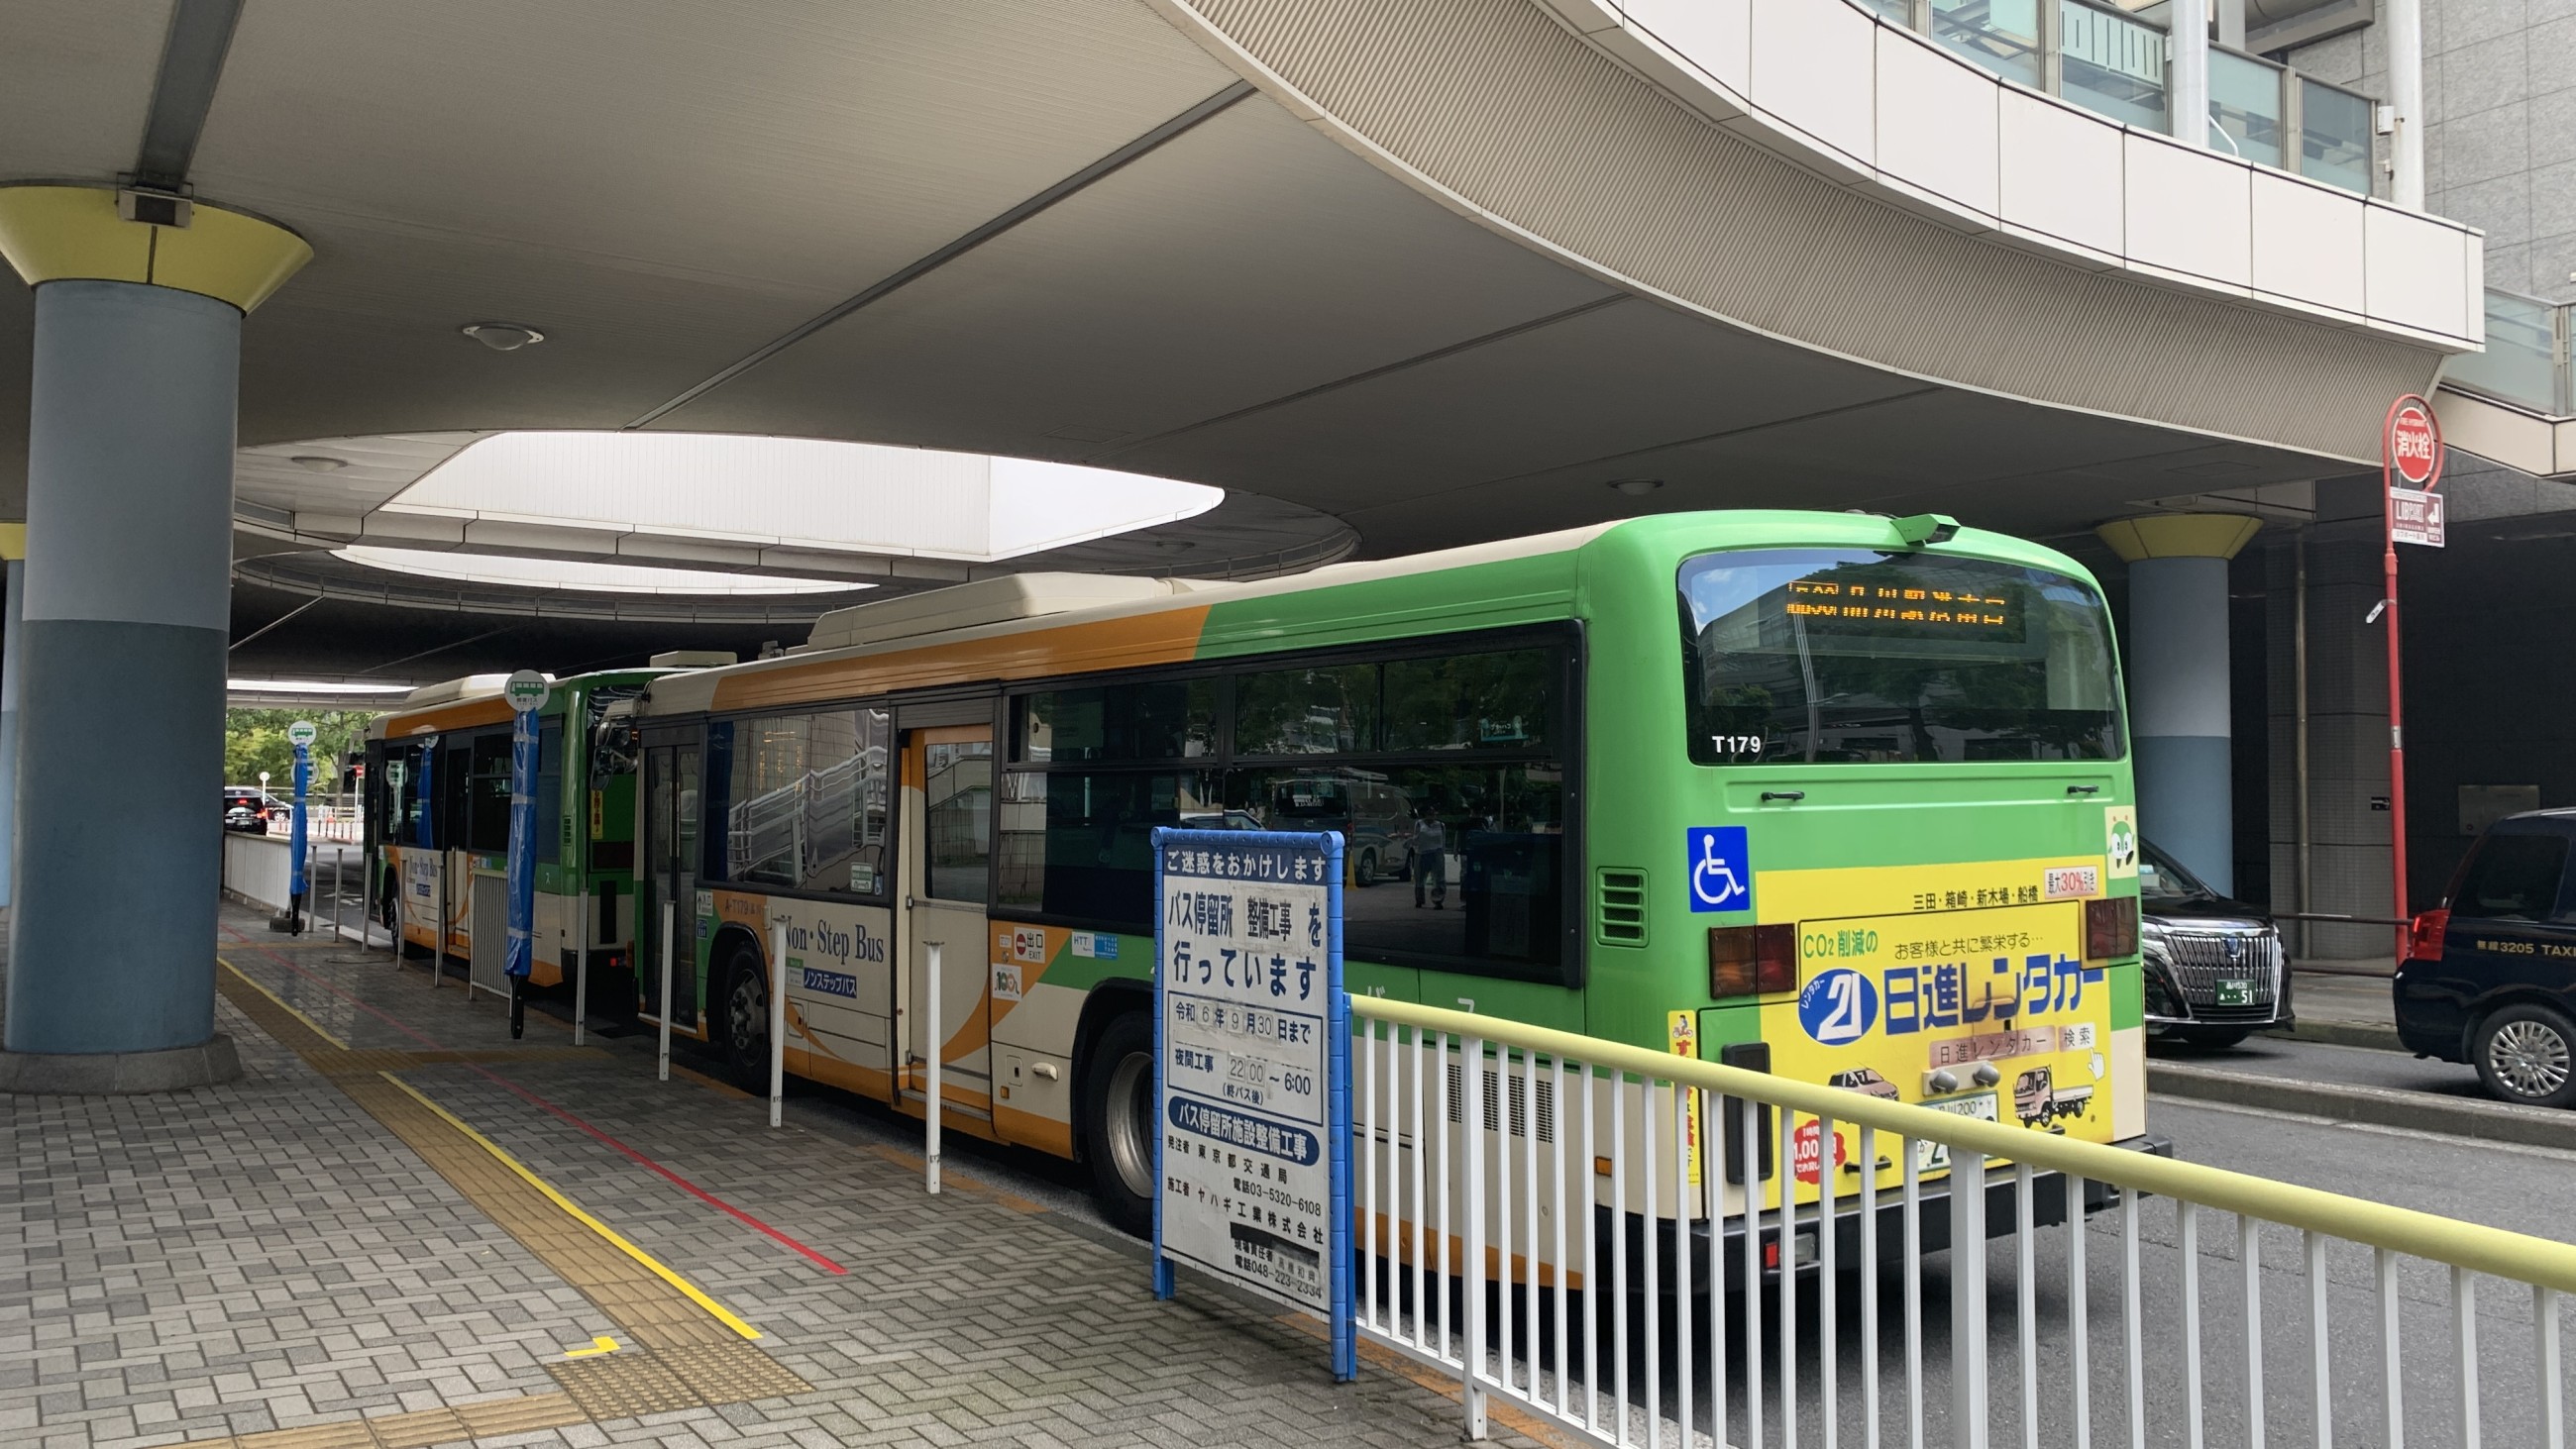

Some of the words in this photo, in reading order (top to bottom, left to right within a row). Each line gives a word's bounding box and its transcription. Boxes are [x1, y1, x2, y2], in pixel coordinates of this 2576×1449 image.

[2397, 429, 2431, 460] 消火栓
[1711, 735, 1762, 754] T179
[1167, 850, 1326, 881] ご迷惑をおかけします
[1168, 889, 1234, 938] バス停留所
[1246, 896, 1292, 942] 整備工事
[1308, 902, 1322, 948] を
[855, 923, 885, 964] Bus
[1026, 932, 1043, 949] 出口
[1028, 950, 1041, 961] EXIT
[805, 971, 857, 995] ノンステップバス
[1173, 940, 1317, 1001] 行っています
[1800, 979, 1826, 1009] レンタカー
[1883, 954, 2105, 1036] 日進レンタカー
[1174, 1048, 1214, 1074] 夜間工事
[1940, 1034, 2047, 1065] 日進レンタカー
[2063, 1027, 2092, 1048] 検索
[1179, 1102, 1308, 1161] バス停留所施設整備工事
[1198, 1143, 1288, 1186] 東京都交通局
[1198, 1188, 1324, 1245] ヤハギ工業株式会社
